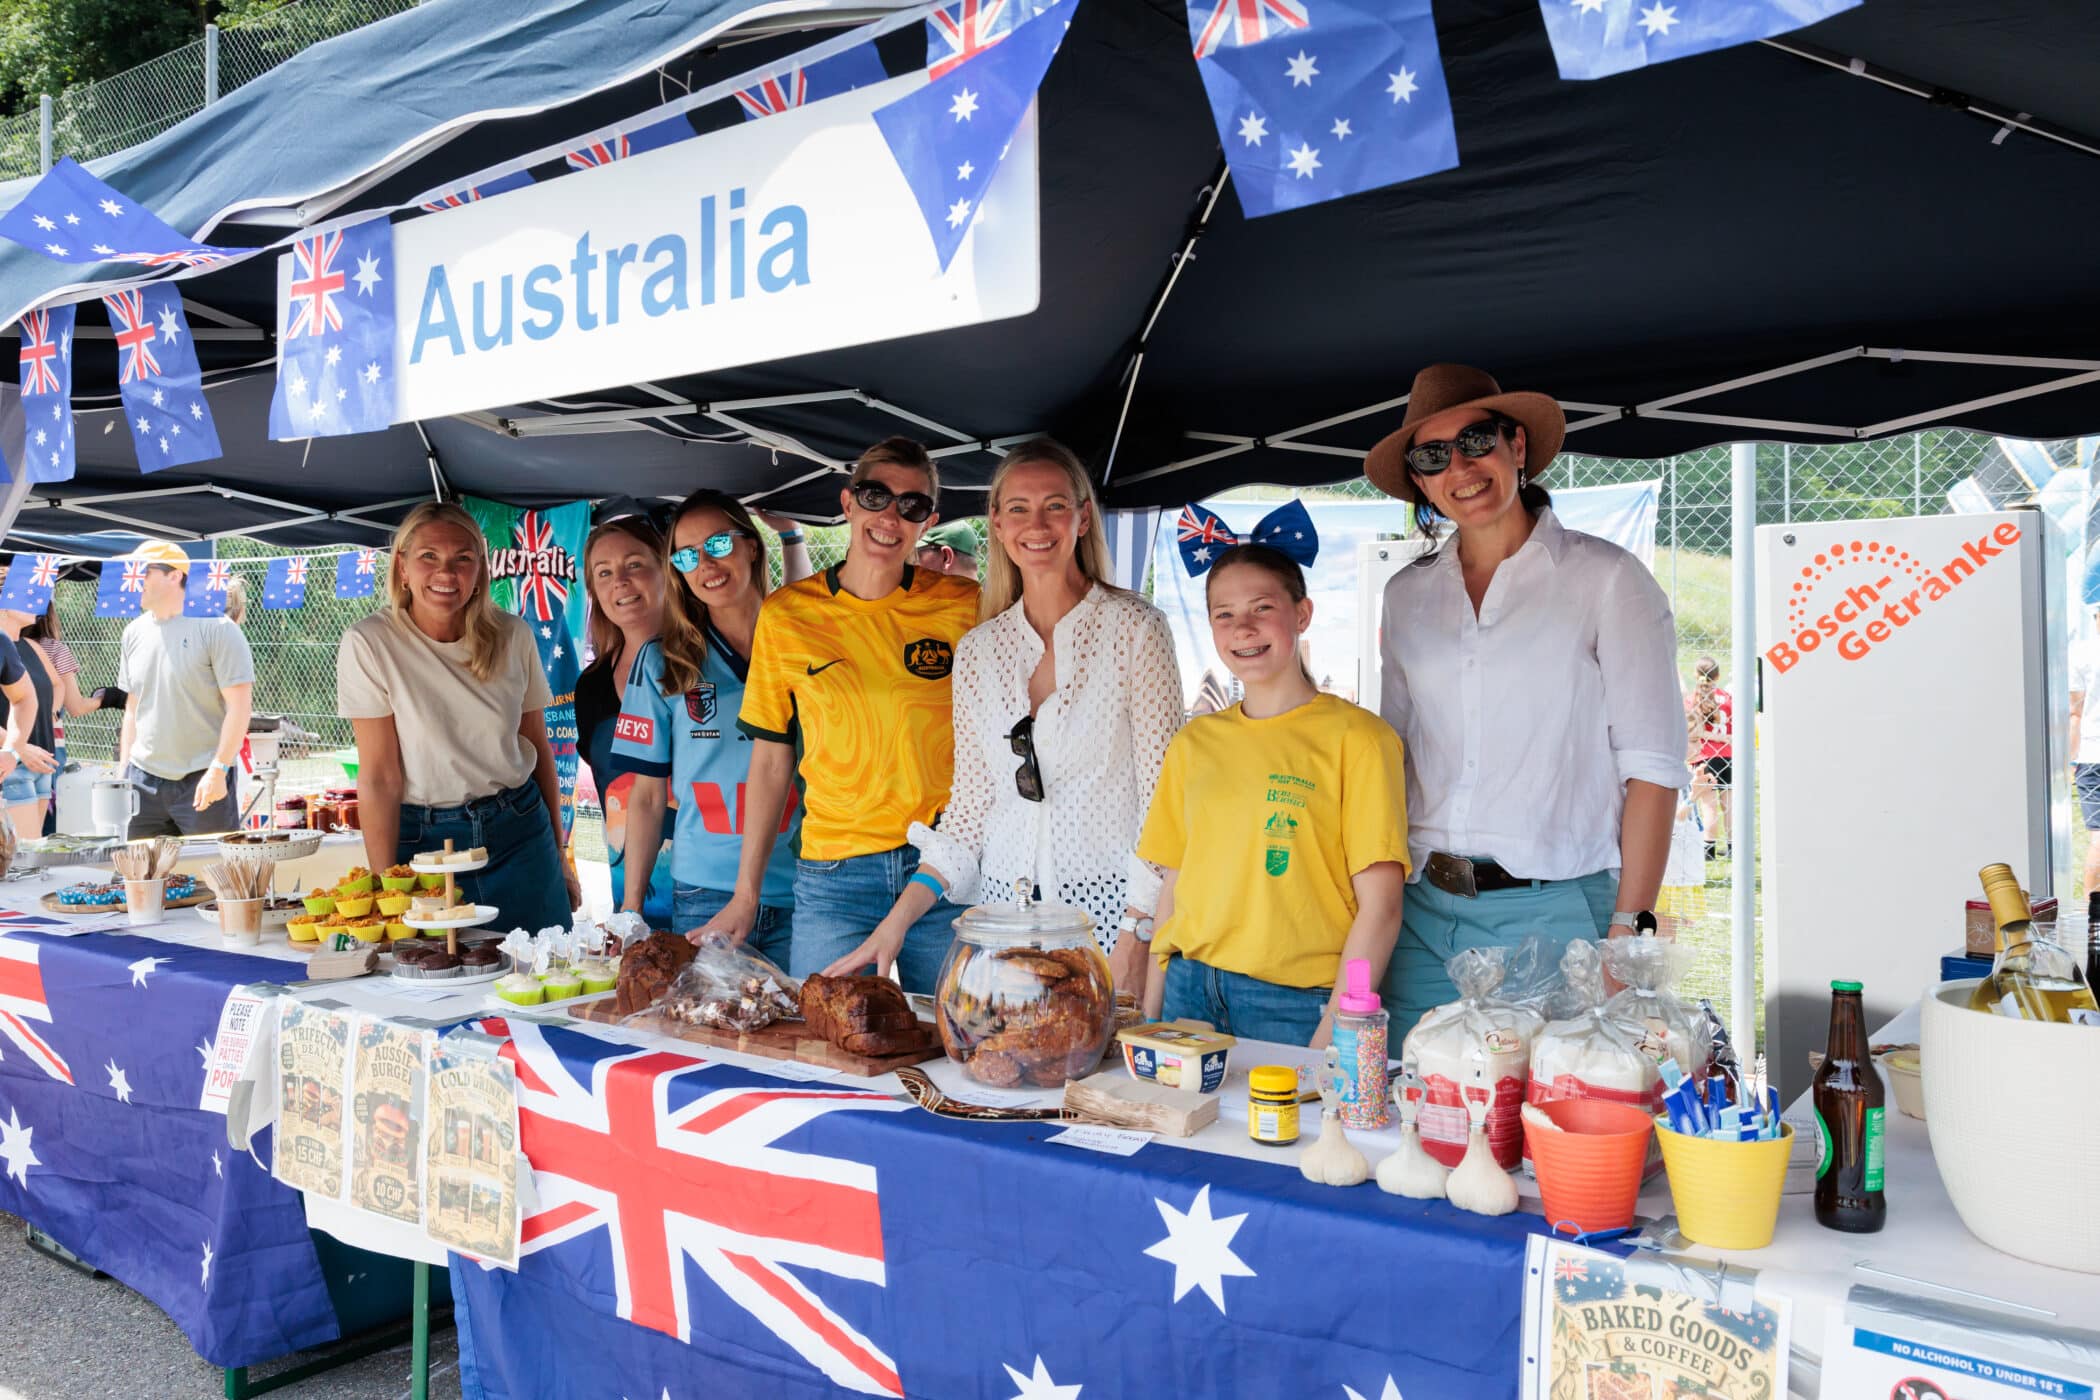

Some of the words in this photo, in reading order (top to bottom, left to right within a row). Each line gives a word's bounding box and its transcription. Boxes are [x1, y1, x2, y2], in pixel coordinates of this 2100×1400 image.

[409, 187, 811, 365] Australia
[491, 545, 576, 582] ustralia
[544, 709, 576, 722] SBANE
[556, 726, 577, 738] COAS
[615, 718, 649, 739] HEYS
[229, 1003, 254, 1018] PLEASE
[229, 1017, 247, 1032] NOTE
[291, 1026, 336, 1055] TRIFECTA
[375, 1045, 413, 1067] AUSSIE
[441, 1071, 471, 1088] COLD
[1581, 1304, 1662, 1331] BAKED
[1669, 1315, 1753, 1371] GOODS
[1623, 1336, 1636, 1352] &
[1641, 1338, 1713, 1376] COFFEE
[1893, 1342, 1911, 1355] NO
[1912, 1344, 1974, 1372] ALCHOHOL
[1976, 1363, 1993, 1376] TO
[1996, 1367, 2037, 1388] UNDER
